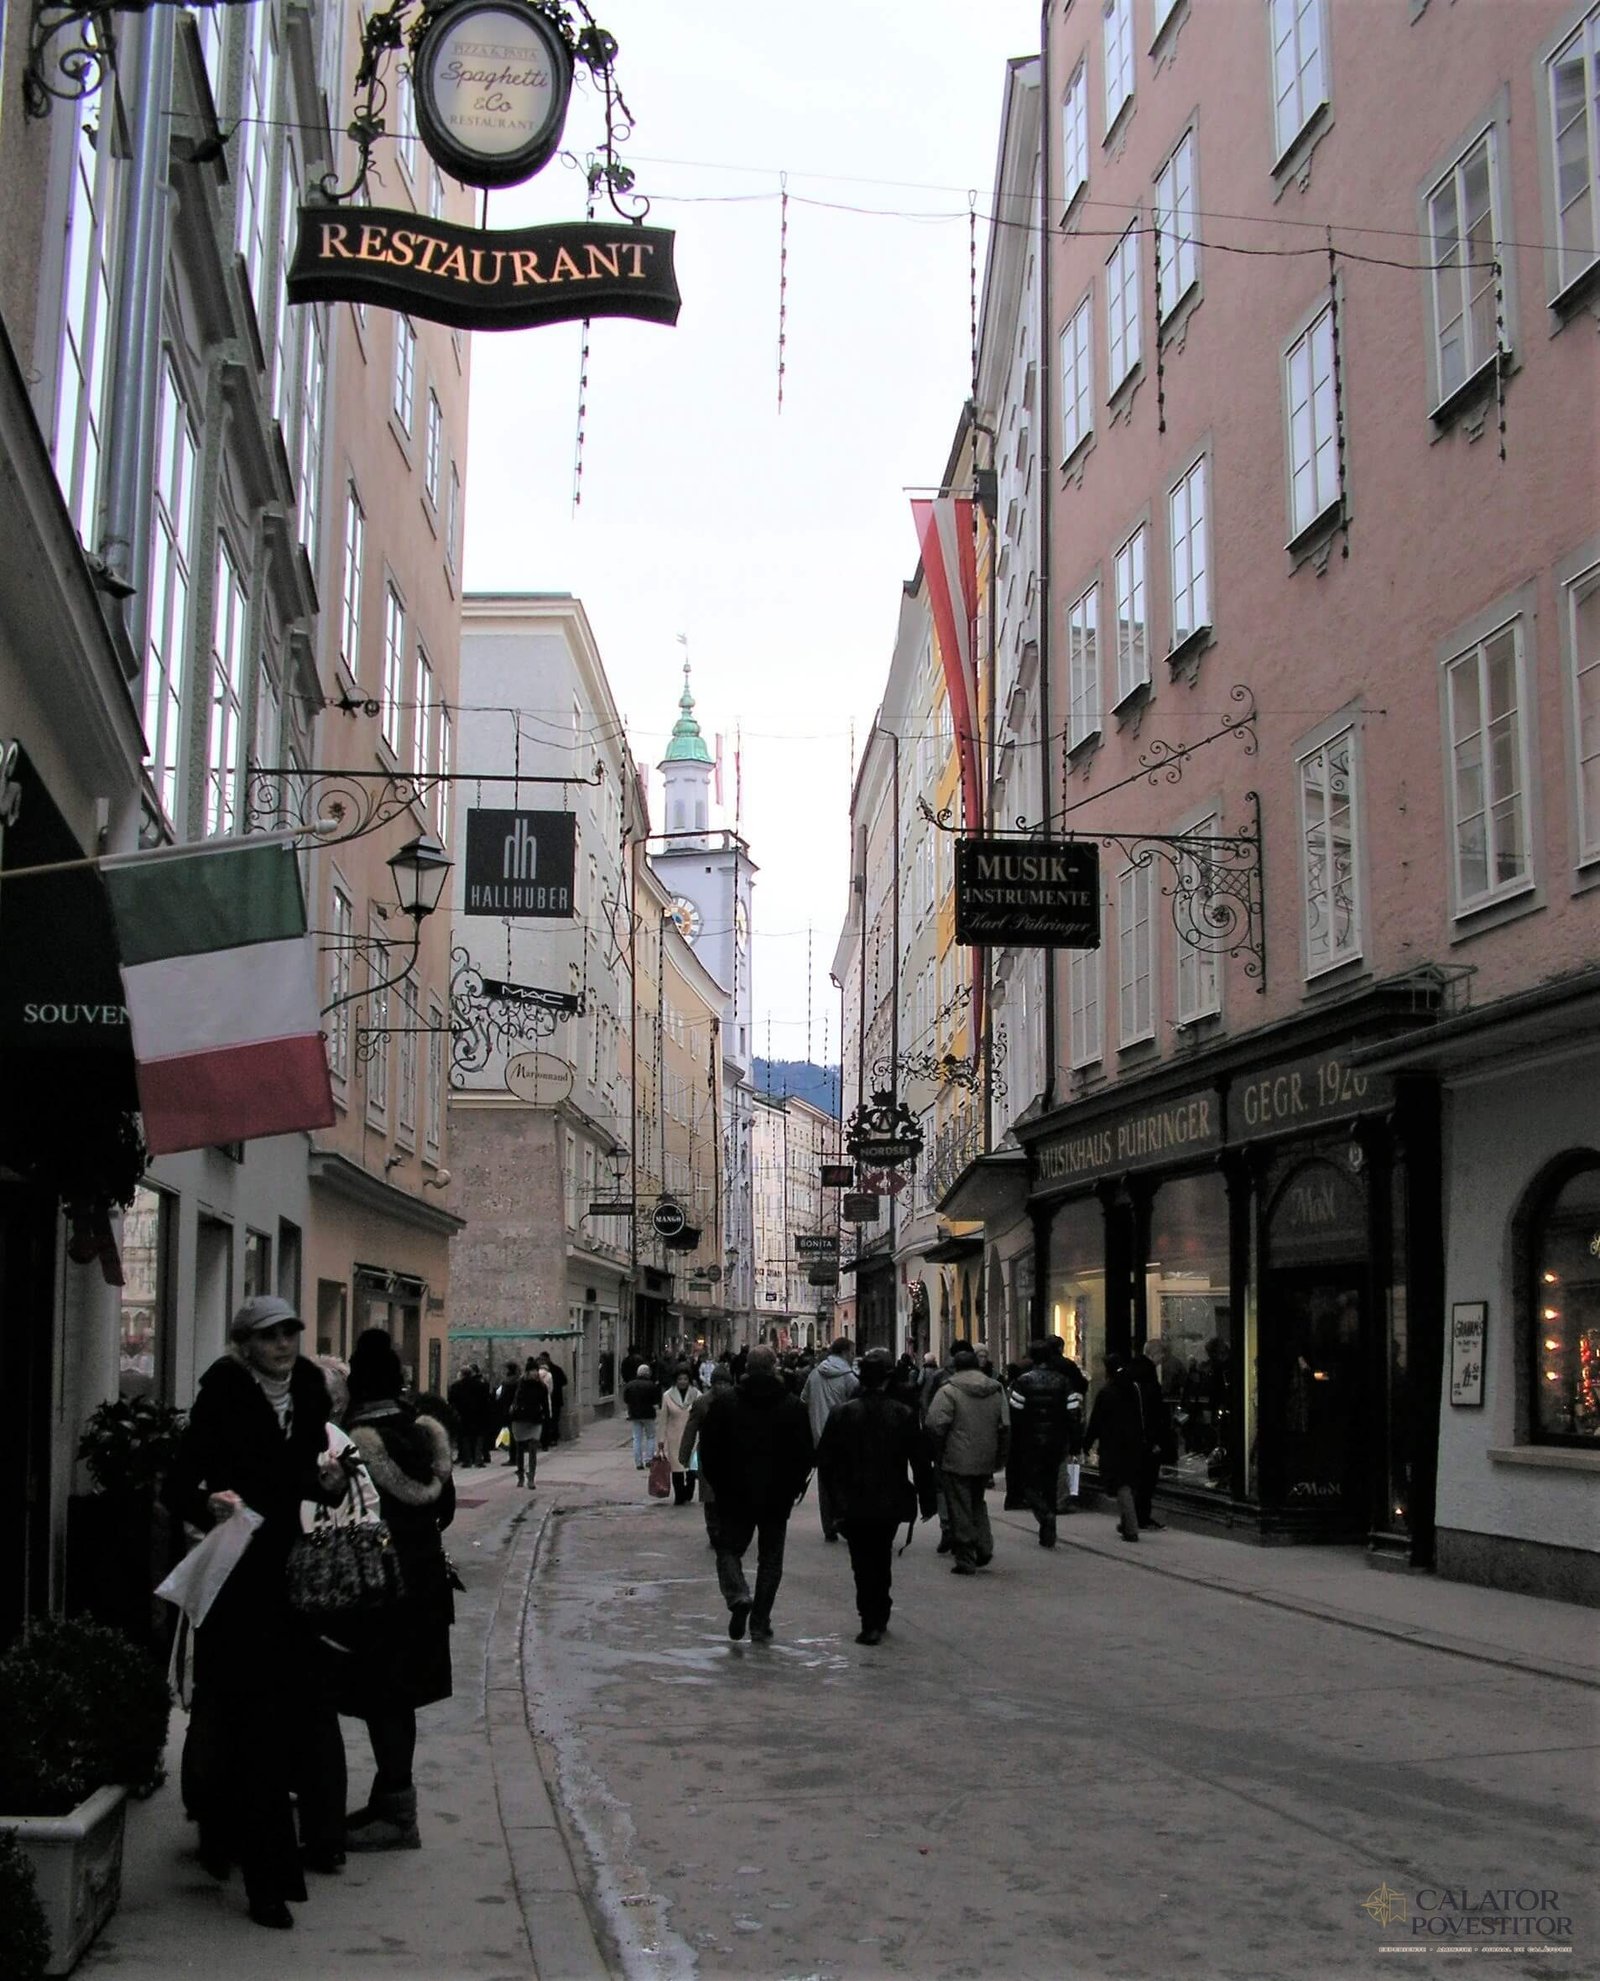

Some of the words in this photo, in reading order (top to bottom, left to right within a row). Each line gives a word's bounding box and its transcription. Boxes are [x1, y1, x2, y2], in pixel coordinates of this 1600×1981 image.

[440, 61, 548, 91] Spaghetti
[449, 115, 536, 131] RESTAURANT
[319, 222, 654, 287] RESTAURANT
[977, 854, 1079, 883] MUSIK-
[470, 884, 569, 911] HALLHUBER
[965, 887, 1091, 907] INSTRUMENTE
[965, 911, 1008, 930] Karl
[1039, 1130, 1113, 1182] MUSIKHAUS
[1117, 1100, 1211, 1161] PÜHRINGER
[1243, 1072, 1309, 1126] GEGR.
[800, 1239, 833, 1248] BONITA
